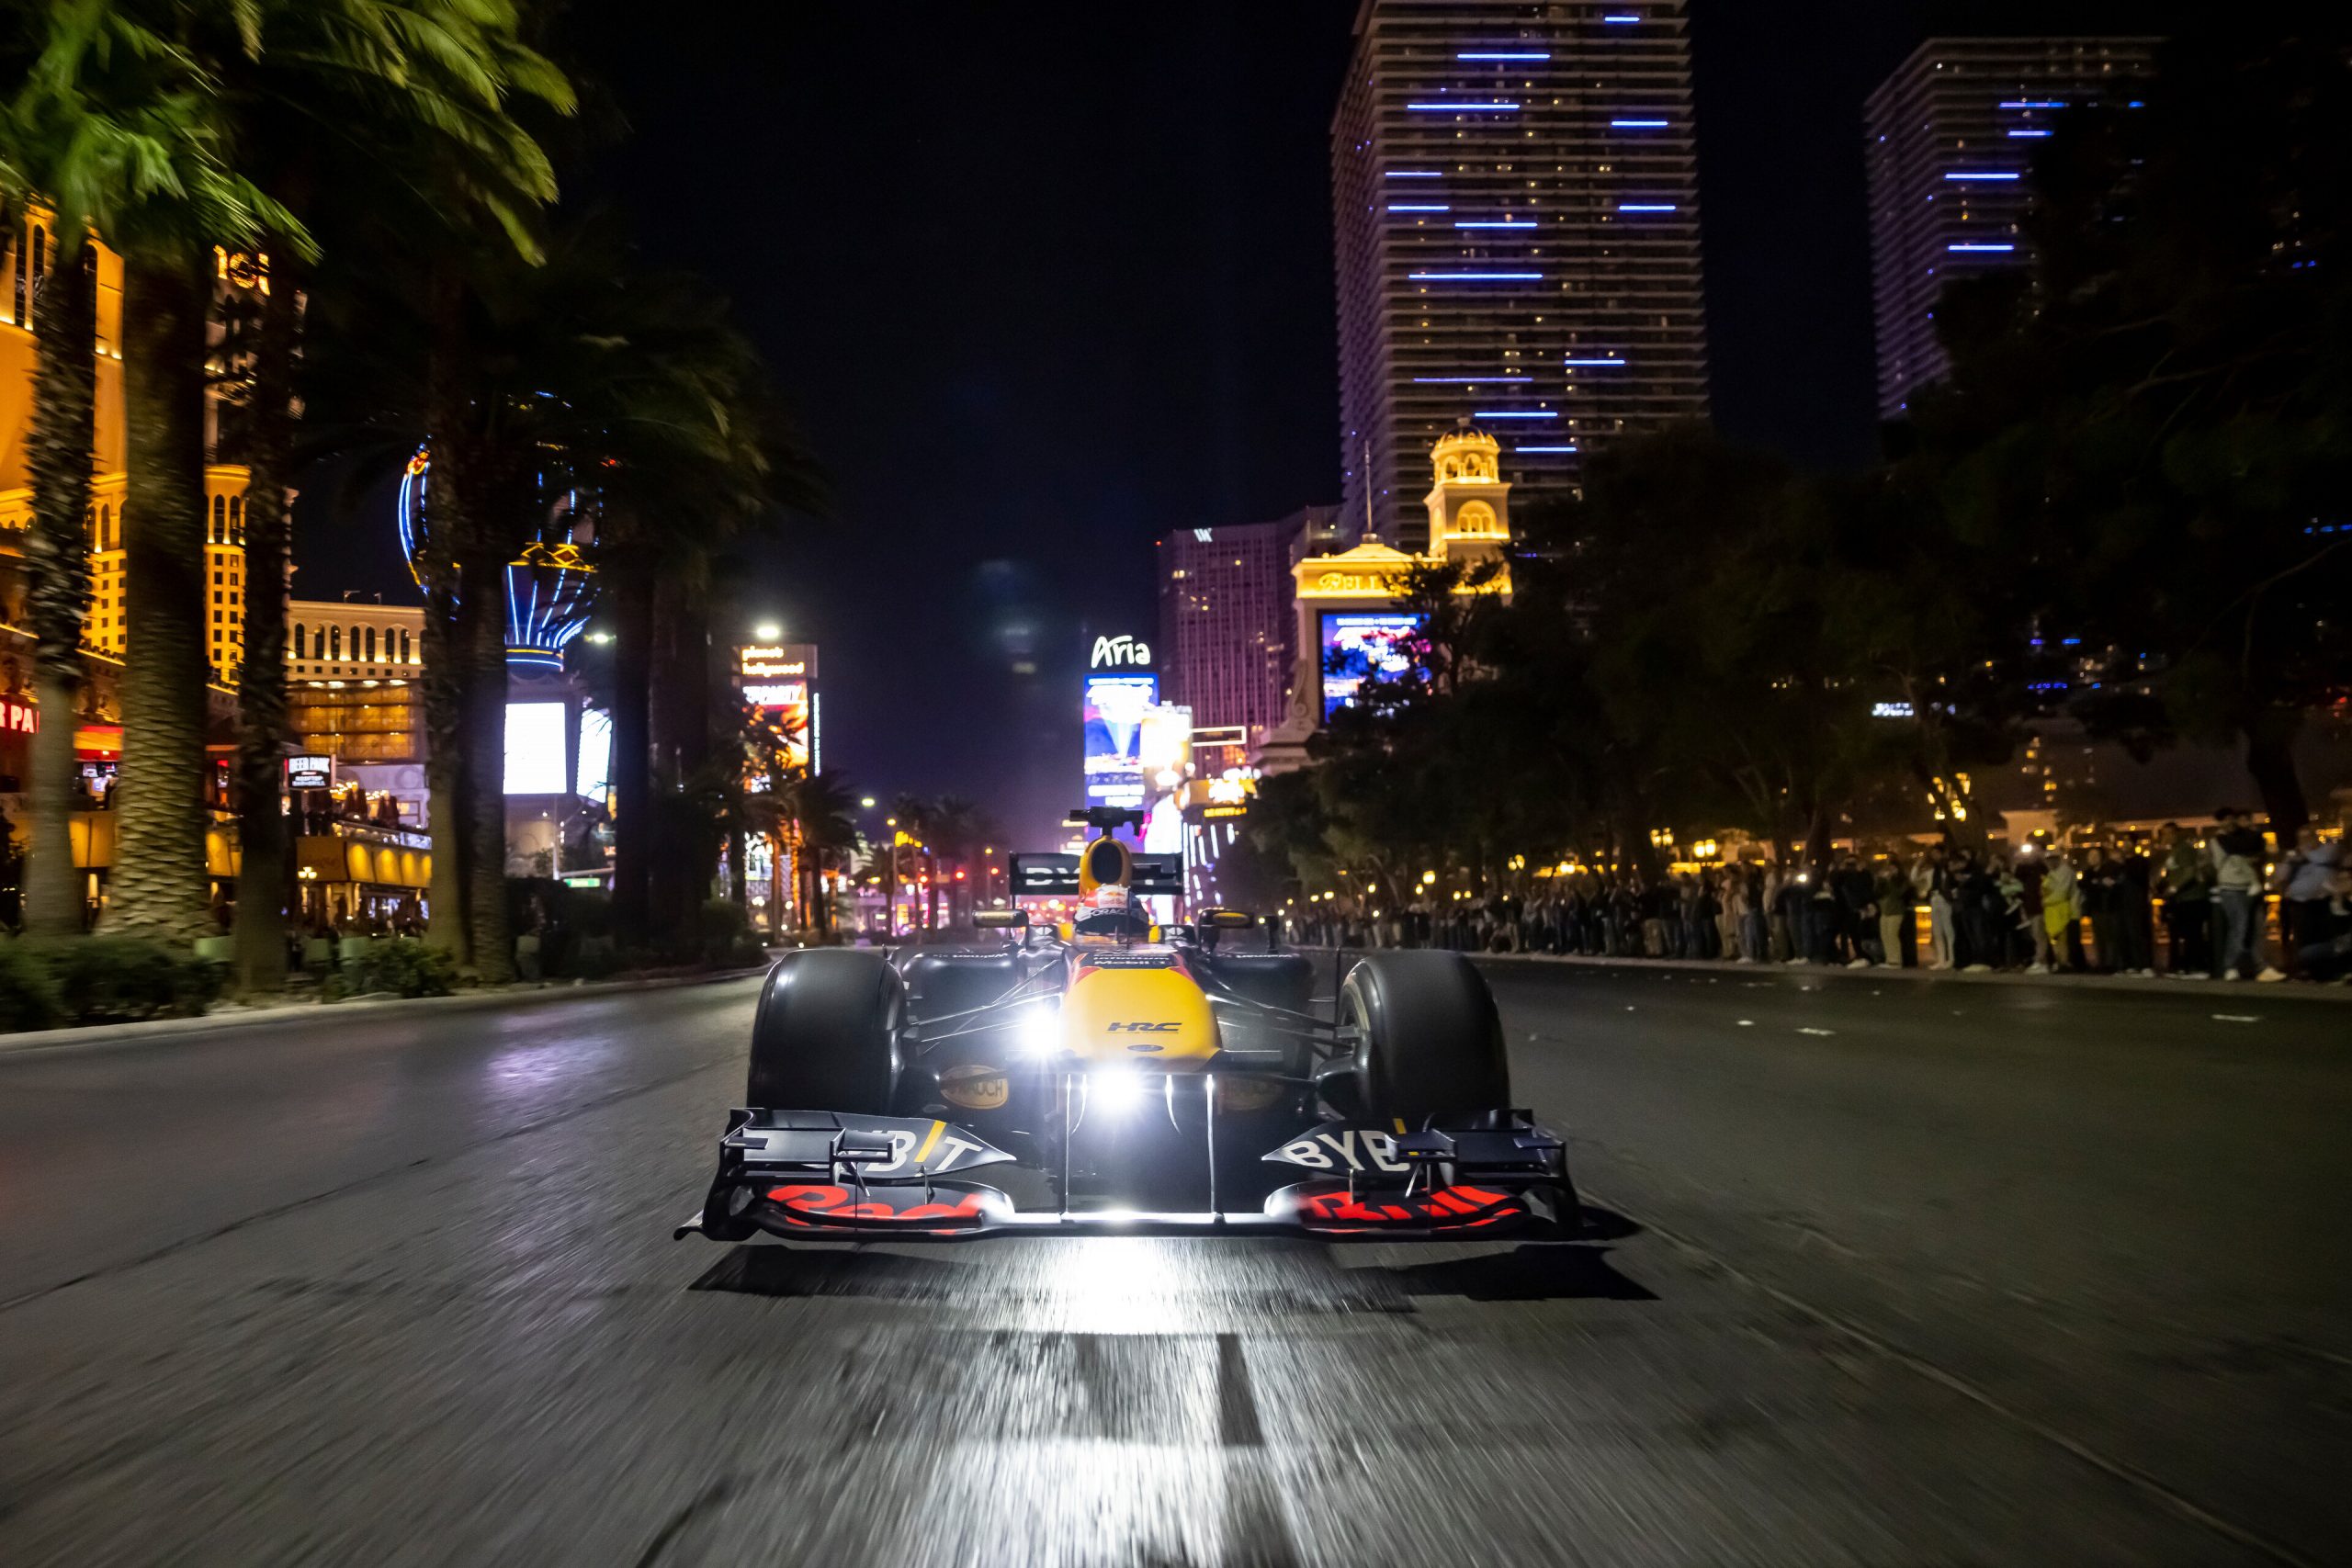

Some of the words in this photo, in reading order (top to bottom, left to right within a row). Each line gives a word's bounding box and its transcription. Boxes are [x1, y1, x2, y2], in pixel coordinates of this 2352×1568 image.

[741, 661, 805, 677] hollywood
[1091, 635, 1151, 669] Aria
[1107, 1021, 1183, 1032] HRC
[863, 1120, 984, 1172] BIT
[1285, 1118, 1412, 1172] BYB
